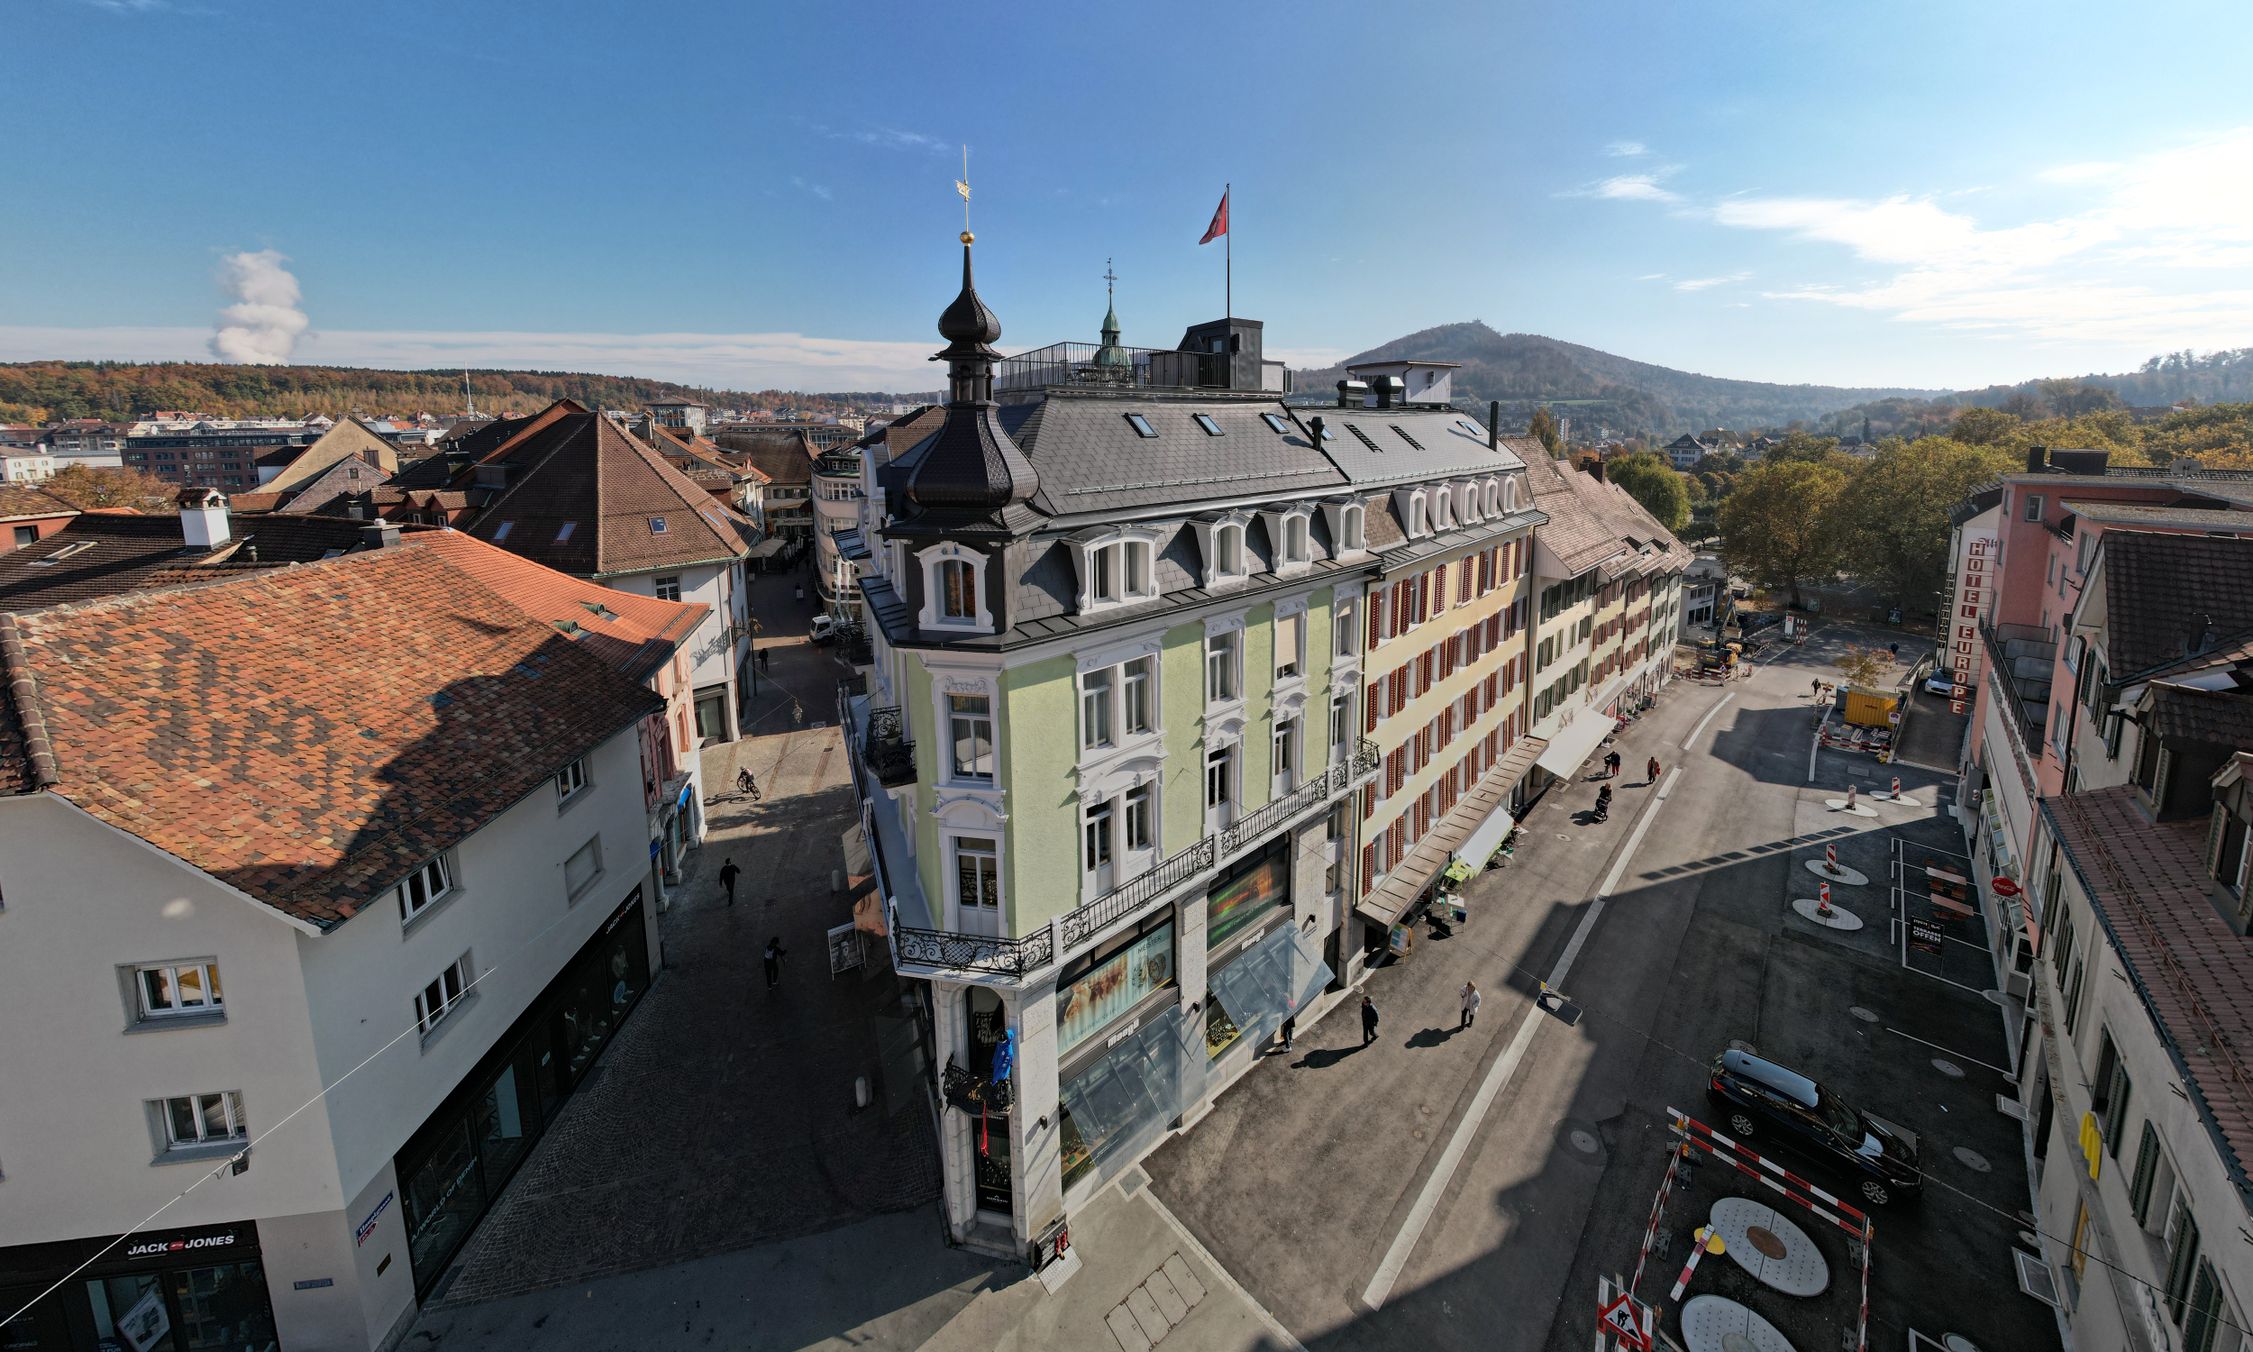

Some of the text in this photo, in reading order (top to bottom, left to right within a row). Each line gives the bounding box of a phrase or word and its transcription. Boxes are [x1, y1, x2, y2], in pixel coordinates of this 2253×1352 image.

[1939, 574, 1953, 647] RESTAURANT
[1951, 544, 1984, 713] HOTEL EUROPE
[1137, 935, 1162, 954] MEISTER
[1912, 930, 1942, 943] OFFEN
[127, 1235, 235, 1255] JACK JONES
